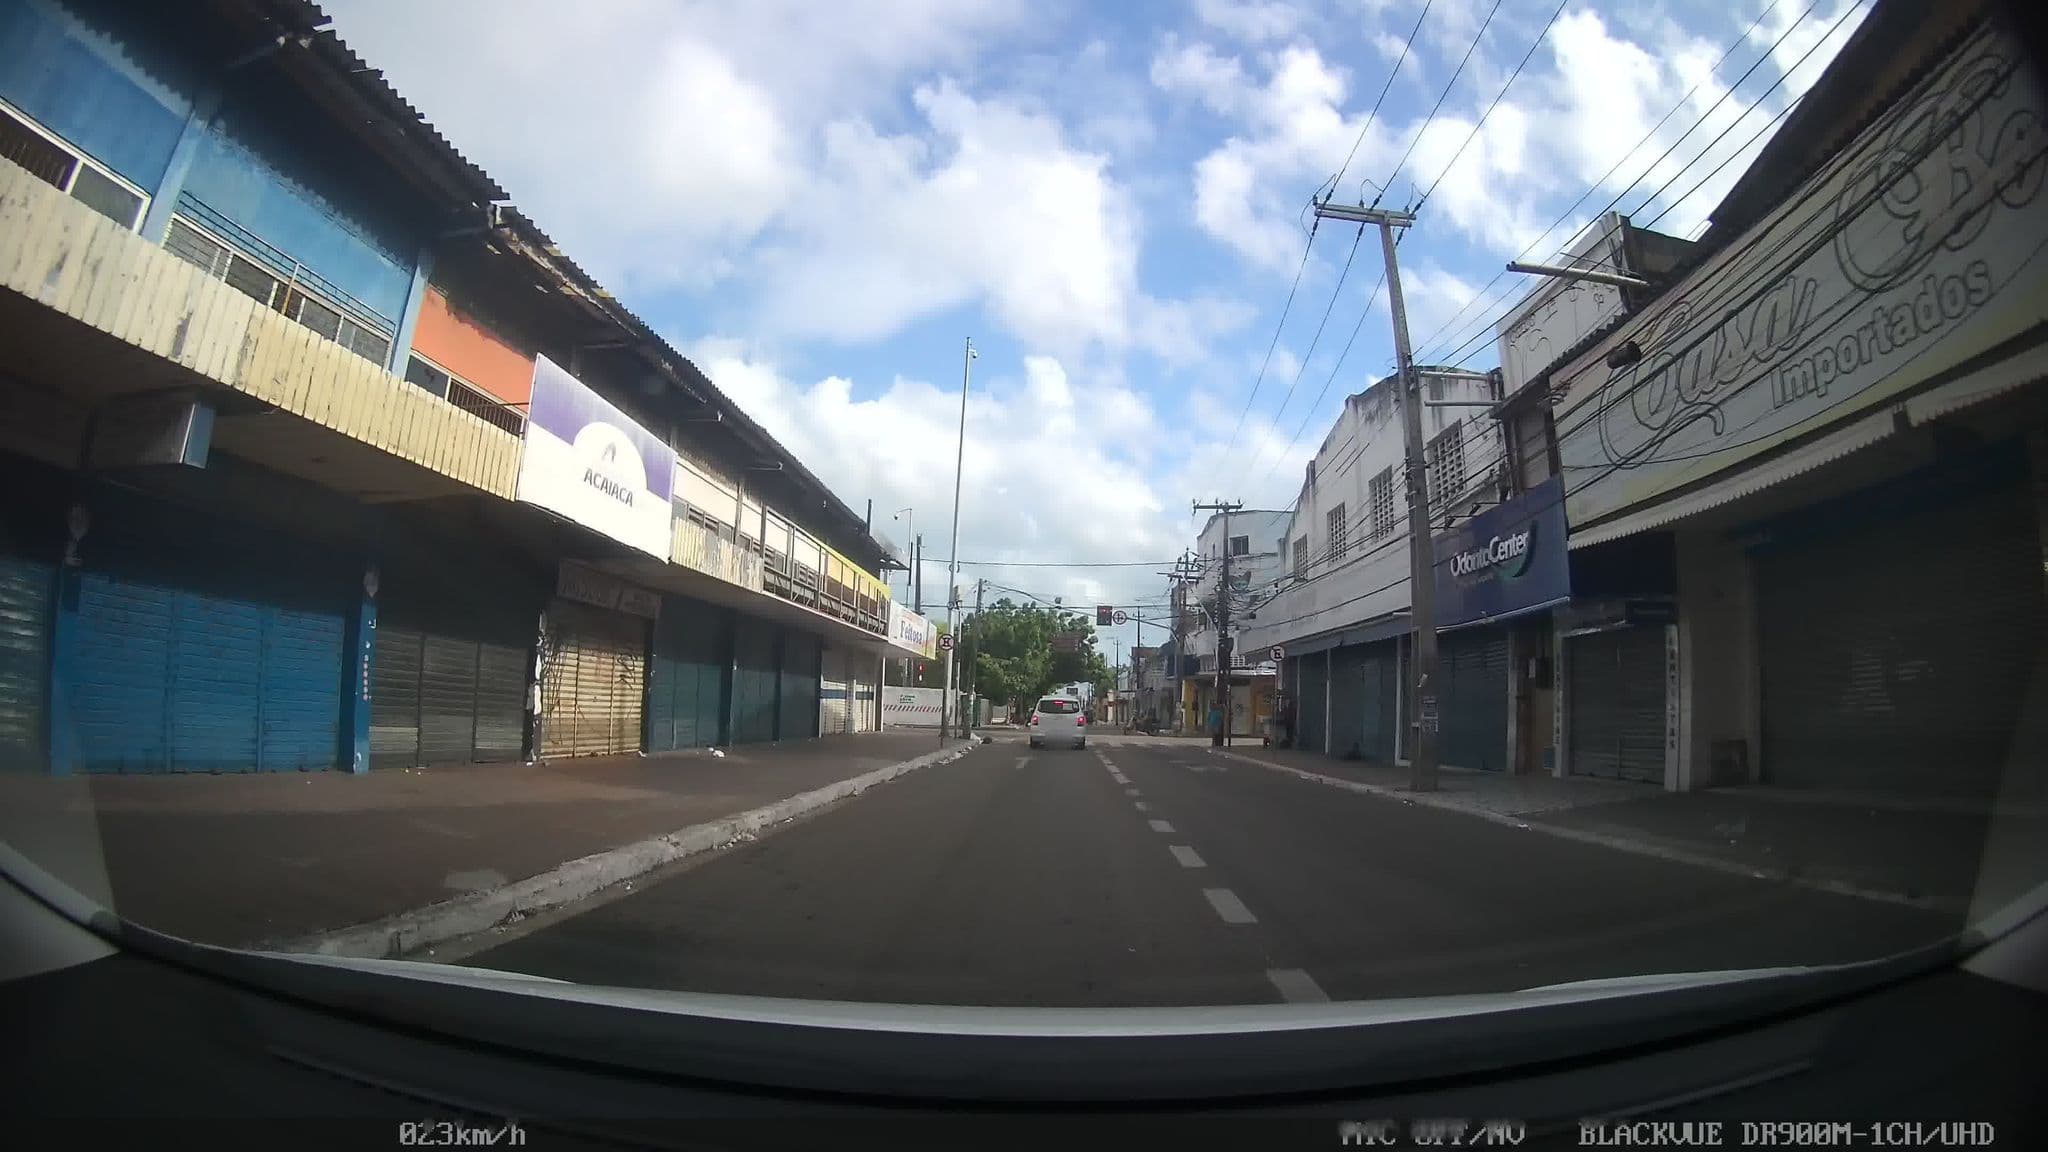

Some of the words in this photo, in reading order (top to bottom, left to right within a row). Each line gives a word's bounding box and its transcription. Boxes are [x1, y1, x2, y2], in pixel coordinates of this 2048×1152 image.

[1770, 259, 1993, 410] Importados
[584, 467, 633, 507] ACAIACA
[1450, 531, 1529, 577] OdontoCenter
[900, 620, 923, 645] Feitosa
